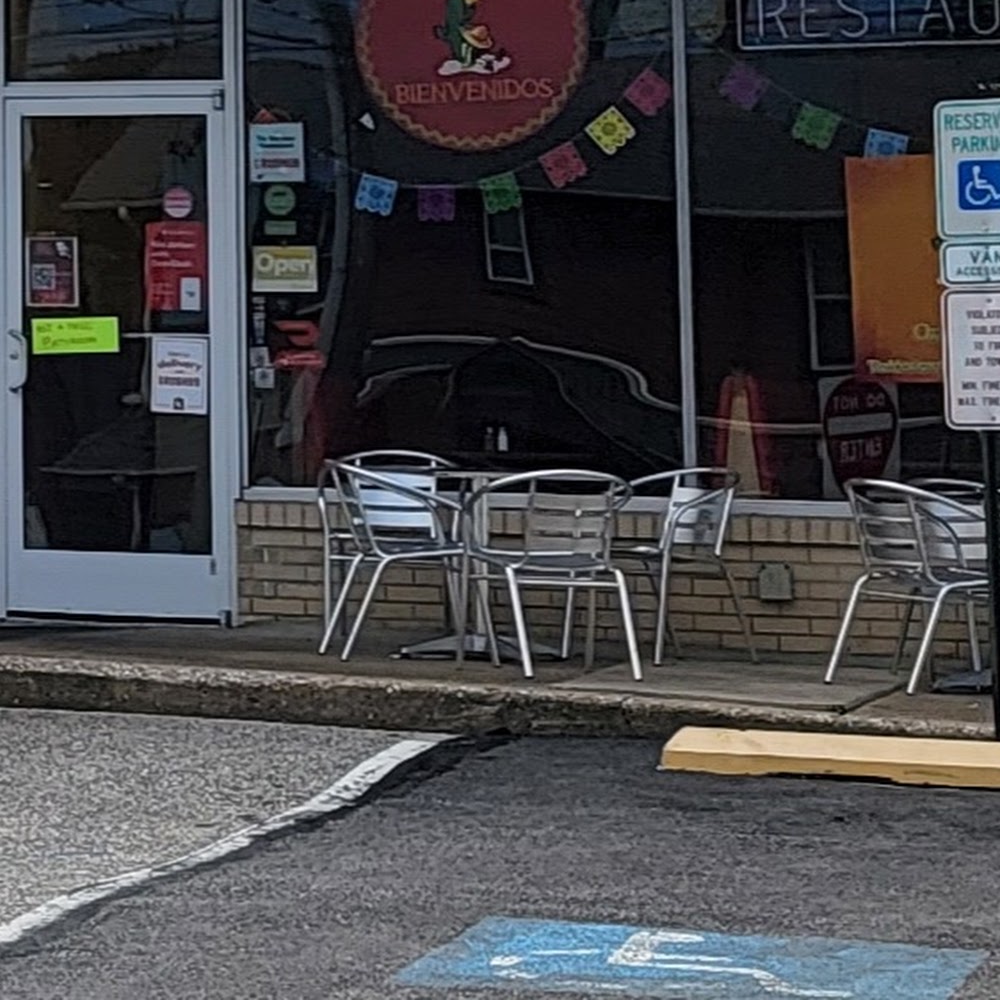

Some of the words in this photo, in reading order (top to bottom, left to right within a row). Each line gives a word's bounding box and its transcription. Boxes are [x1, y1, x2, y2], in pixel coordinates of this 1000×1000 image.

[395, 78, 554, 104] BIENVENIDOS
[256, 252, 314, 276] Open
[965, 358, 982, 367] AND
